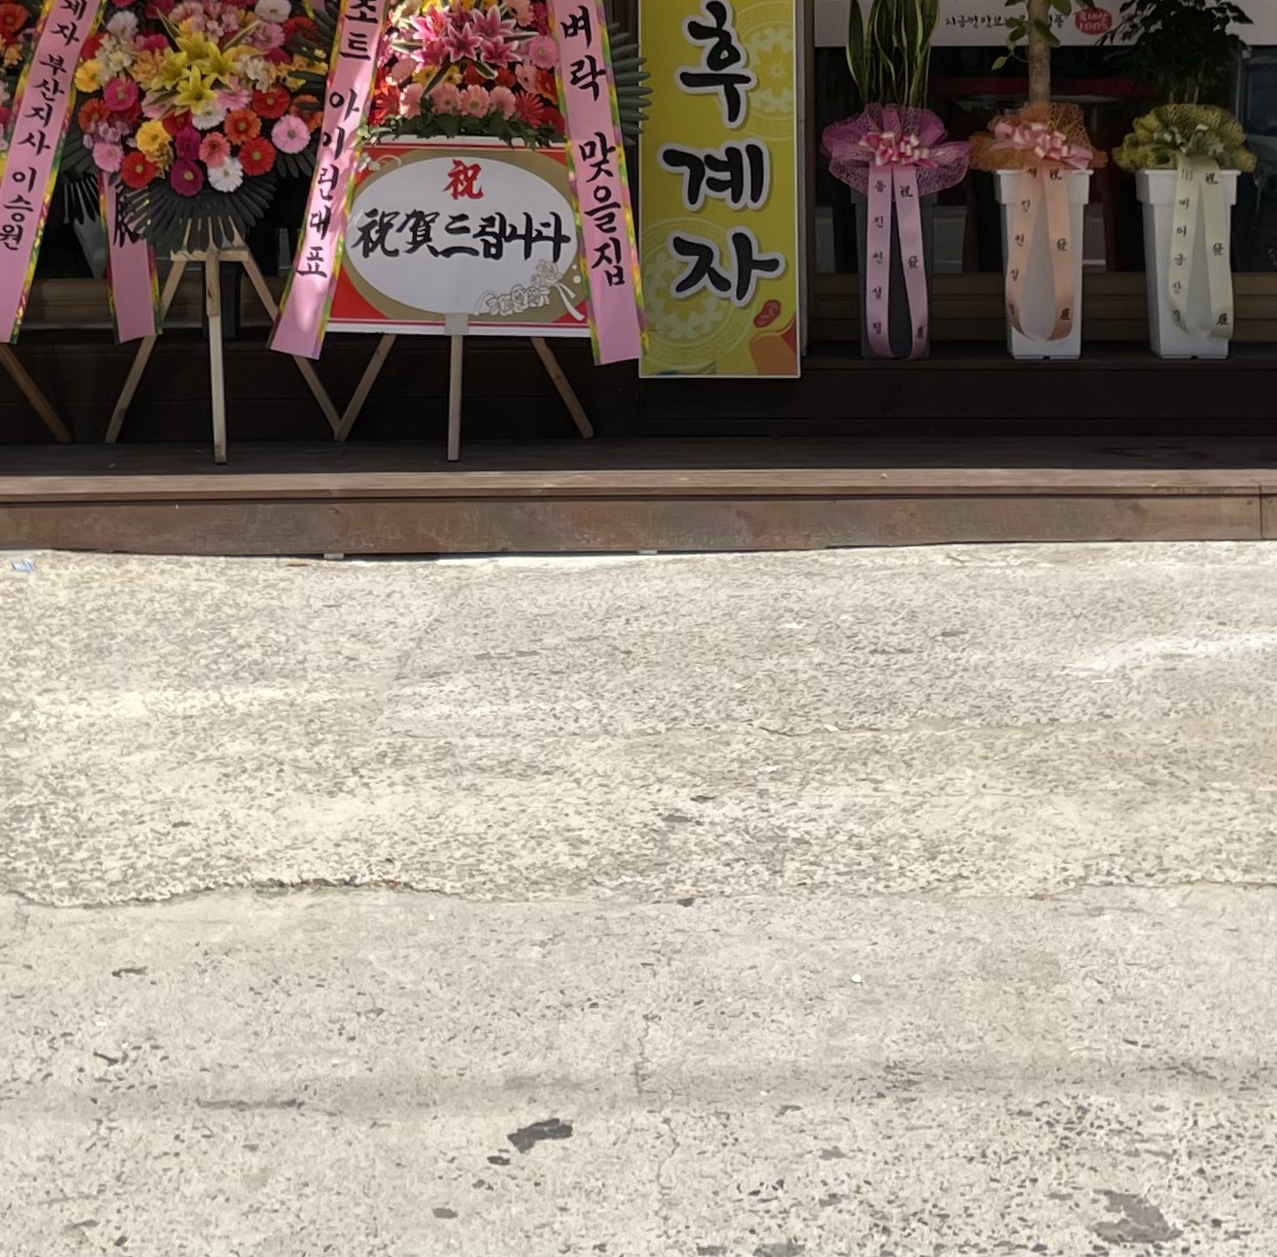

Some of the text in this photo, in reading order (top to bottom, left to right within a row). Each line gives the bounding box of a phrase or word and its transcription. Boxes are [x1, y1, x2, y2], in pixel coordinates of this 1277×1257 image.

[559, 4, 608, 102] 벼락
[16, 53, 70, 158] 부산지사
[442, 158, 486, 201] 祝
[577, 132, 627, 288] 맞을집
